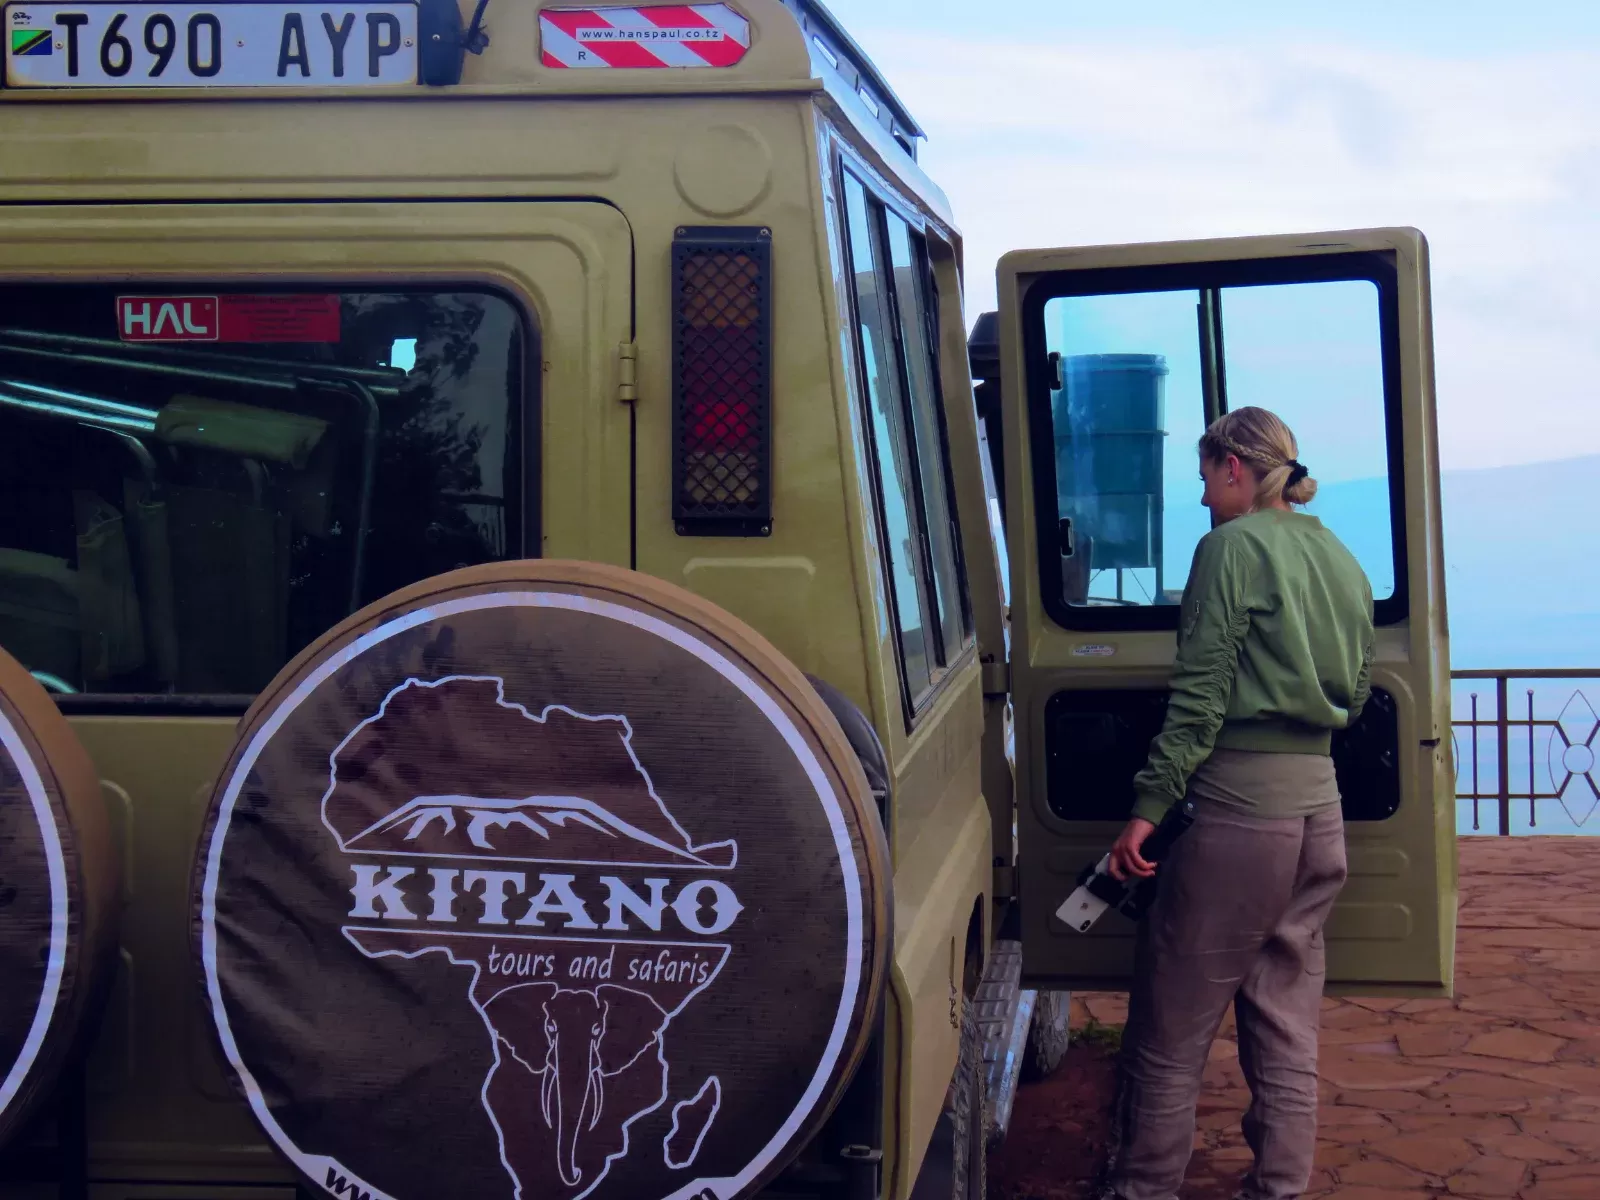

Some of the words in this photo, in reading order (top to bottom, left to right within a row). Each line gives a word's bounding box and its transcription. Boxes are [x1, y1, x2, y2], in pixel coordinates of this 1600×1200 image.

[55, 12, 222, 78] T690
[276, 12, 402, 78] AYP
[582, 30, 719, 40] www.hanspaul.co.tz
[578, 51, 586, 61] R
[123, 302, 208, 335] HAL
[347, 863, 745, 936] KITANO
[487, 943, 555, 977] tours
[568, 943, 616, 980] and
[626, 949, 710, 985] safaris
